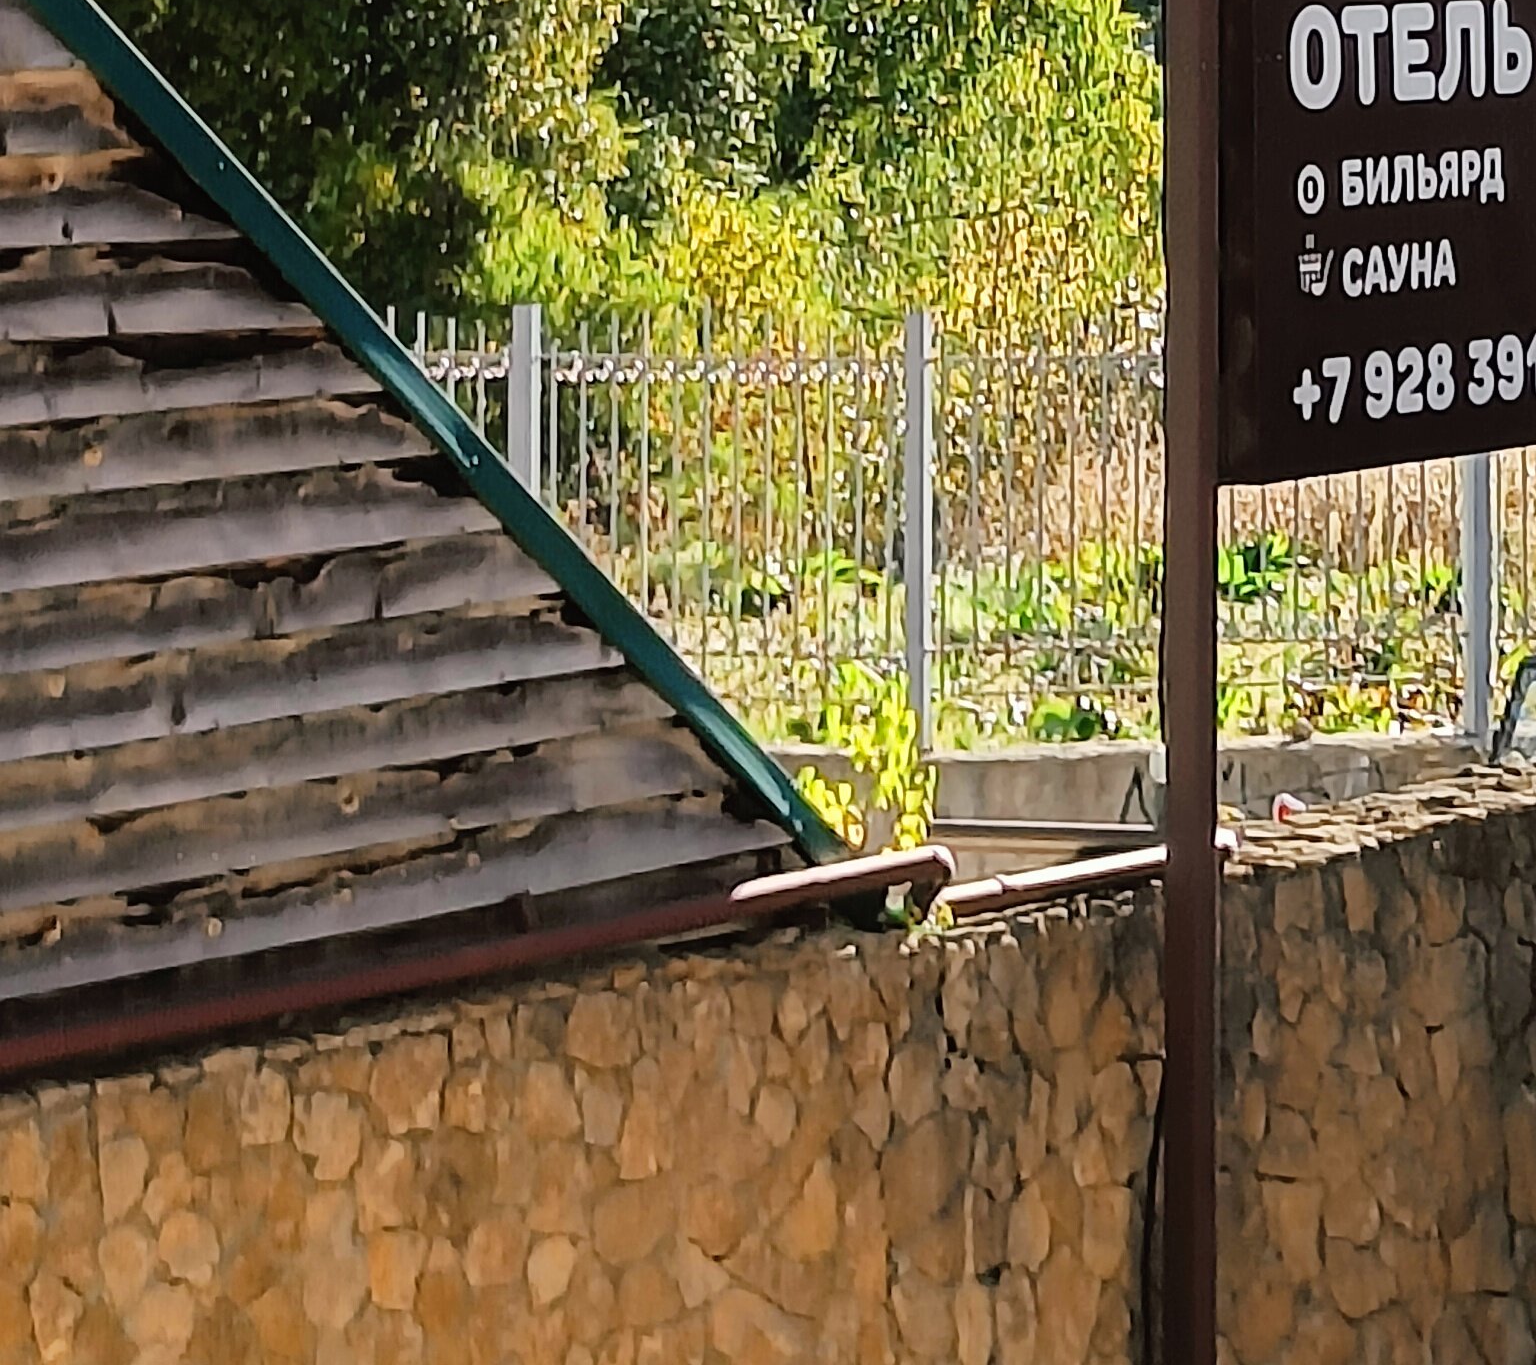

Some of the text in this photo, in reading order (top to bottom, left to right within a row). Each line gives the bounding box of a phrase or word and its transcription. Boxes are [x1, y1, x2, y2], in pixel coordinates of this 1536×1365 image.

[1341, 147, 1505, 207] БИЛЬЯРД
[1342, 238, 1456, 298] САУНА
[1293, 356, 1351, 424] +7
[1364, 342, 1455, 419] 928
